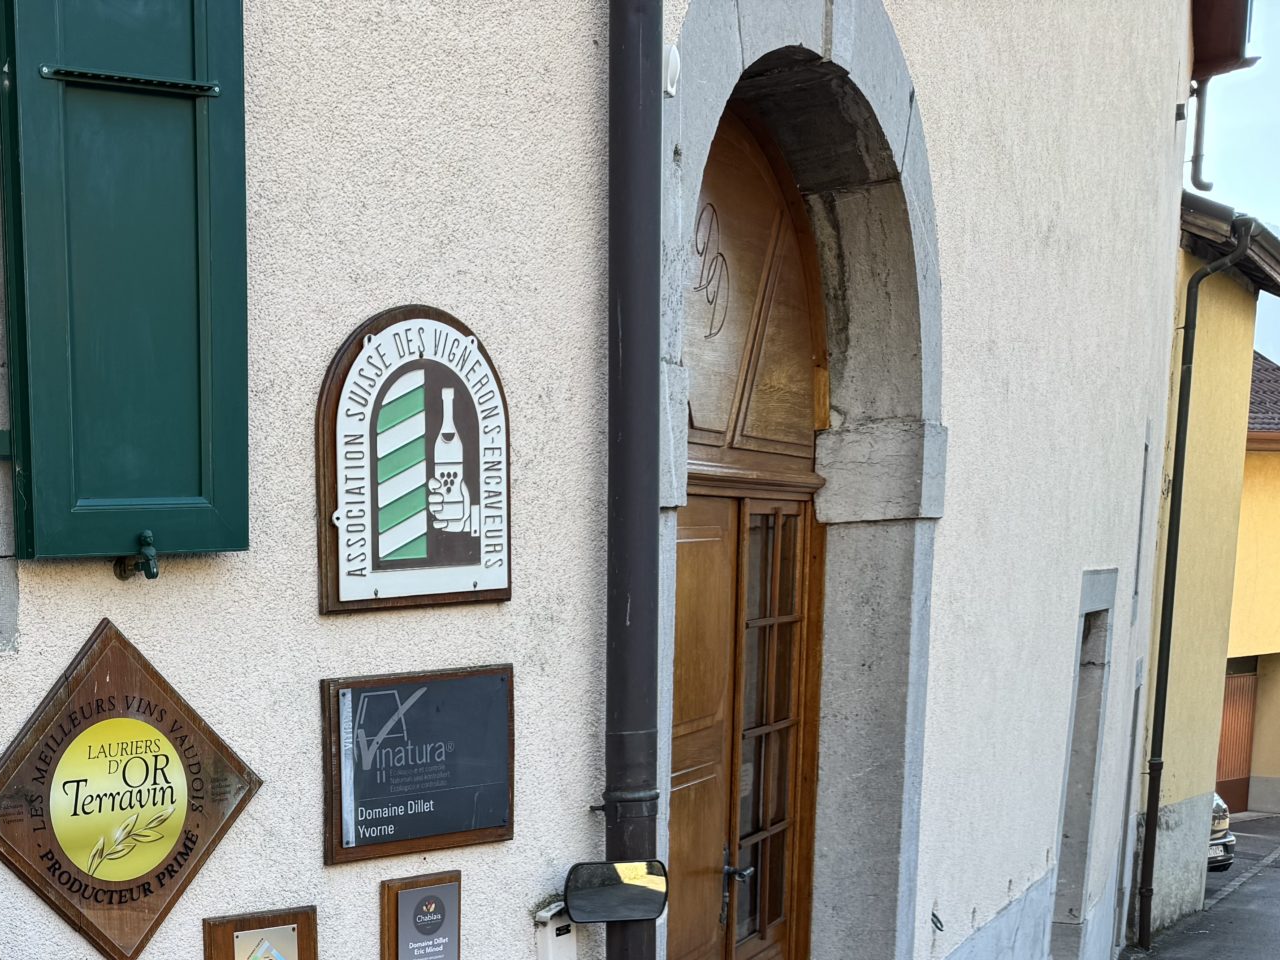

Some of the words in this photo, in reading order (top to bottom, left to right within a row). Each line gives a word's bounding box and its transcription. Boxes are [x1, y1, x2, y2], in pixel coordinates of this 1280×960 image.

[393, 327, 426, 360] DES
[346, 343, 392, 422] SUISSE
[343, 433, 367, 577] ASSOCIATION
[125, 695, 167, 723] VINS
[32, 696, 116, 786] MEILLEURS
[88, 739, 161, 760] LAURIERS
[108, 753, 172, 788] D'OR
[170, 720, 204, 813] VAUDOIS
[30, 794, 47, 833] LES
[62, 778, 177, 817] Terravin
[358, 803, 405, 822] Domaine
[407, 799, 435, 815] Dillet
[357, 824, 395, 839] Yvorne
[39, 849, 154, 905] PRODUCTEUR
[155, 829, 199, 888] PRIMÉ
[416, 913, 442, 923] Chablais
[408, 940, 433, 949] Domaine
[433, 937, 449, 945] Dillet
